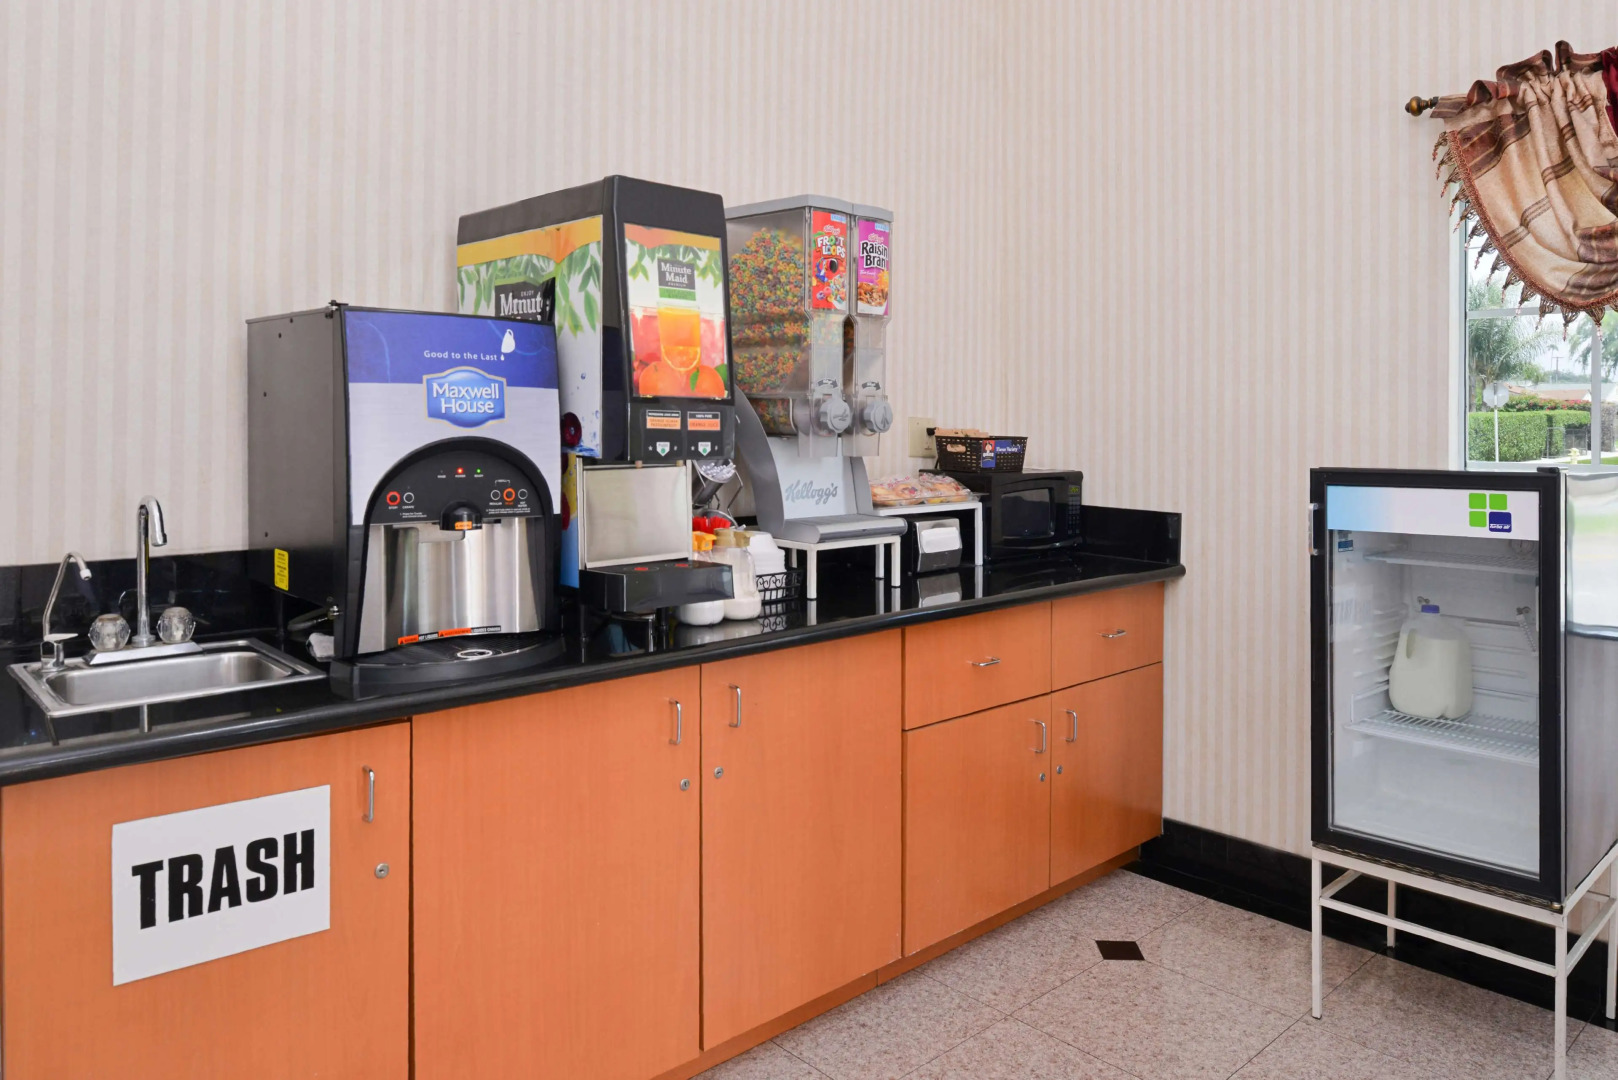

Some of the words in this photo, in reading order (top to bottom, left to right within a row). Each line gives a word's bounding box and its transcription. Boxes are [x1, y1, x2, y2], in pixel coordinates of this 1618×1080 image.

[817, 235, 844, 247] FROOT
[822, 245, 846, 258] LOOPS
[861, 241, 888, 259] Raisin
[661, 261, 692, 275] Minute
[865, 254, 886, 268] Bran
[665, 271, 688, 284] Maid
[423, 350, 449, 359] Good
[463, 352, 478, 360] the
[480, 353, 498, 361] Last
[432, 382, 499, 400] Maxwell
[440, 398, 495, 414] House
[785, 479, 838, 505] Kellogg's
[131, 828, 315, 930] TRASH
